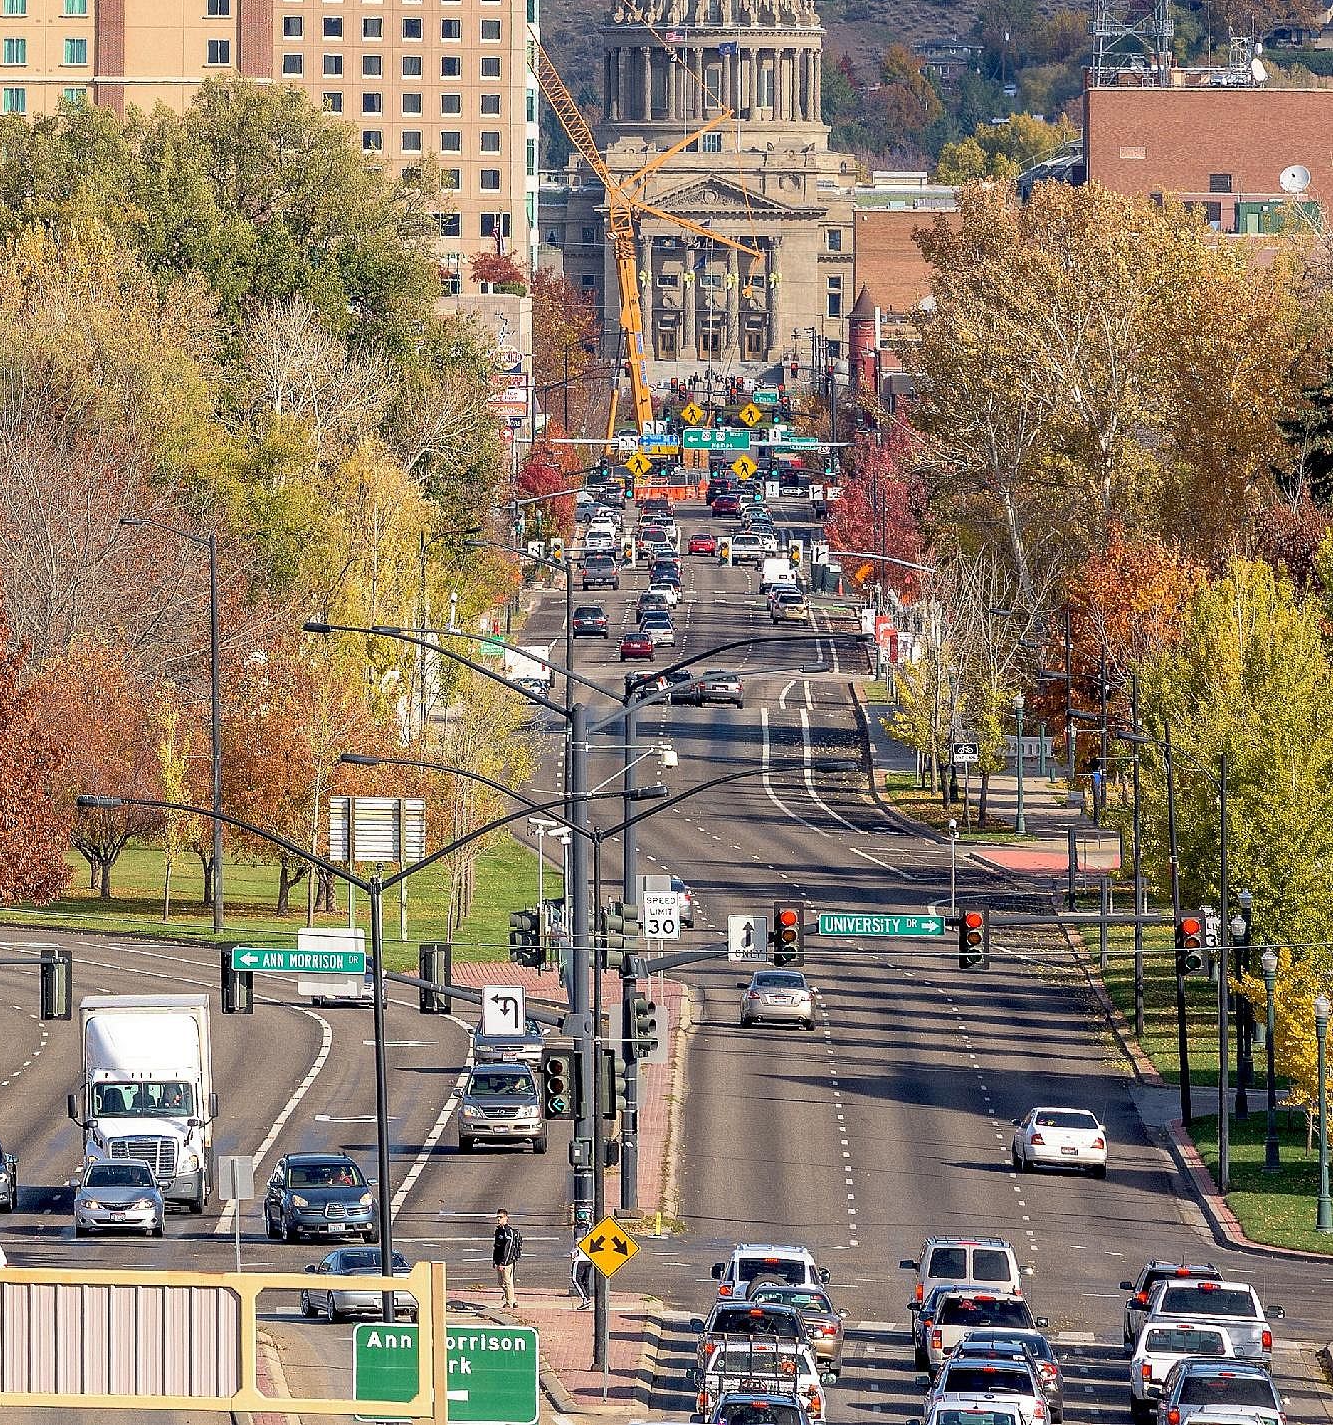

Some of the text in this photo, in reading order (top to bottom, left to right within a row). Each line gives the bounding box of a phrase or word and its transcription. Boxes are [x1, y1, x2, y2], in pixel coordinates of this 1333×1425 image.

[649, 908, 673, 916] LIMIT
[648, 920, 675, 934] 30
[825, 916, 917, 933] UNIVERSITY DR
[263, 952, 359, 969] ANN MORRISON DR
[367, 1331, 526, 1351] Ann orrison
